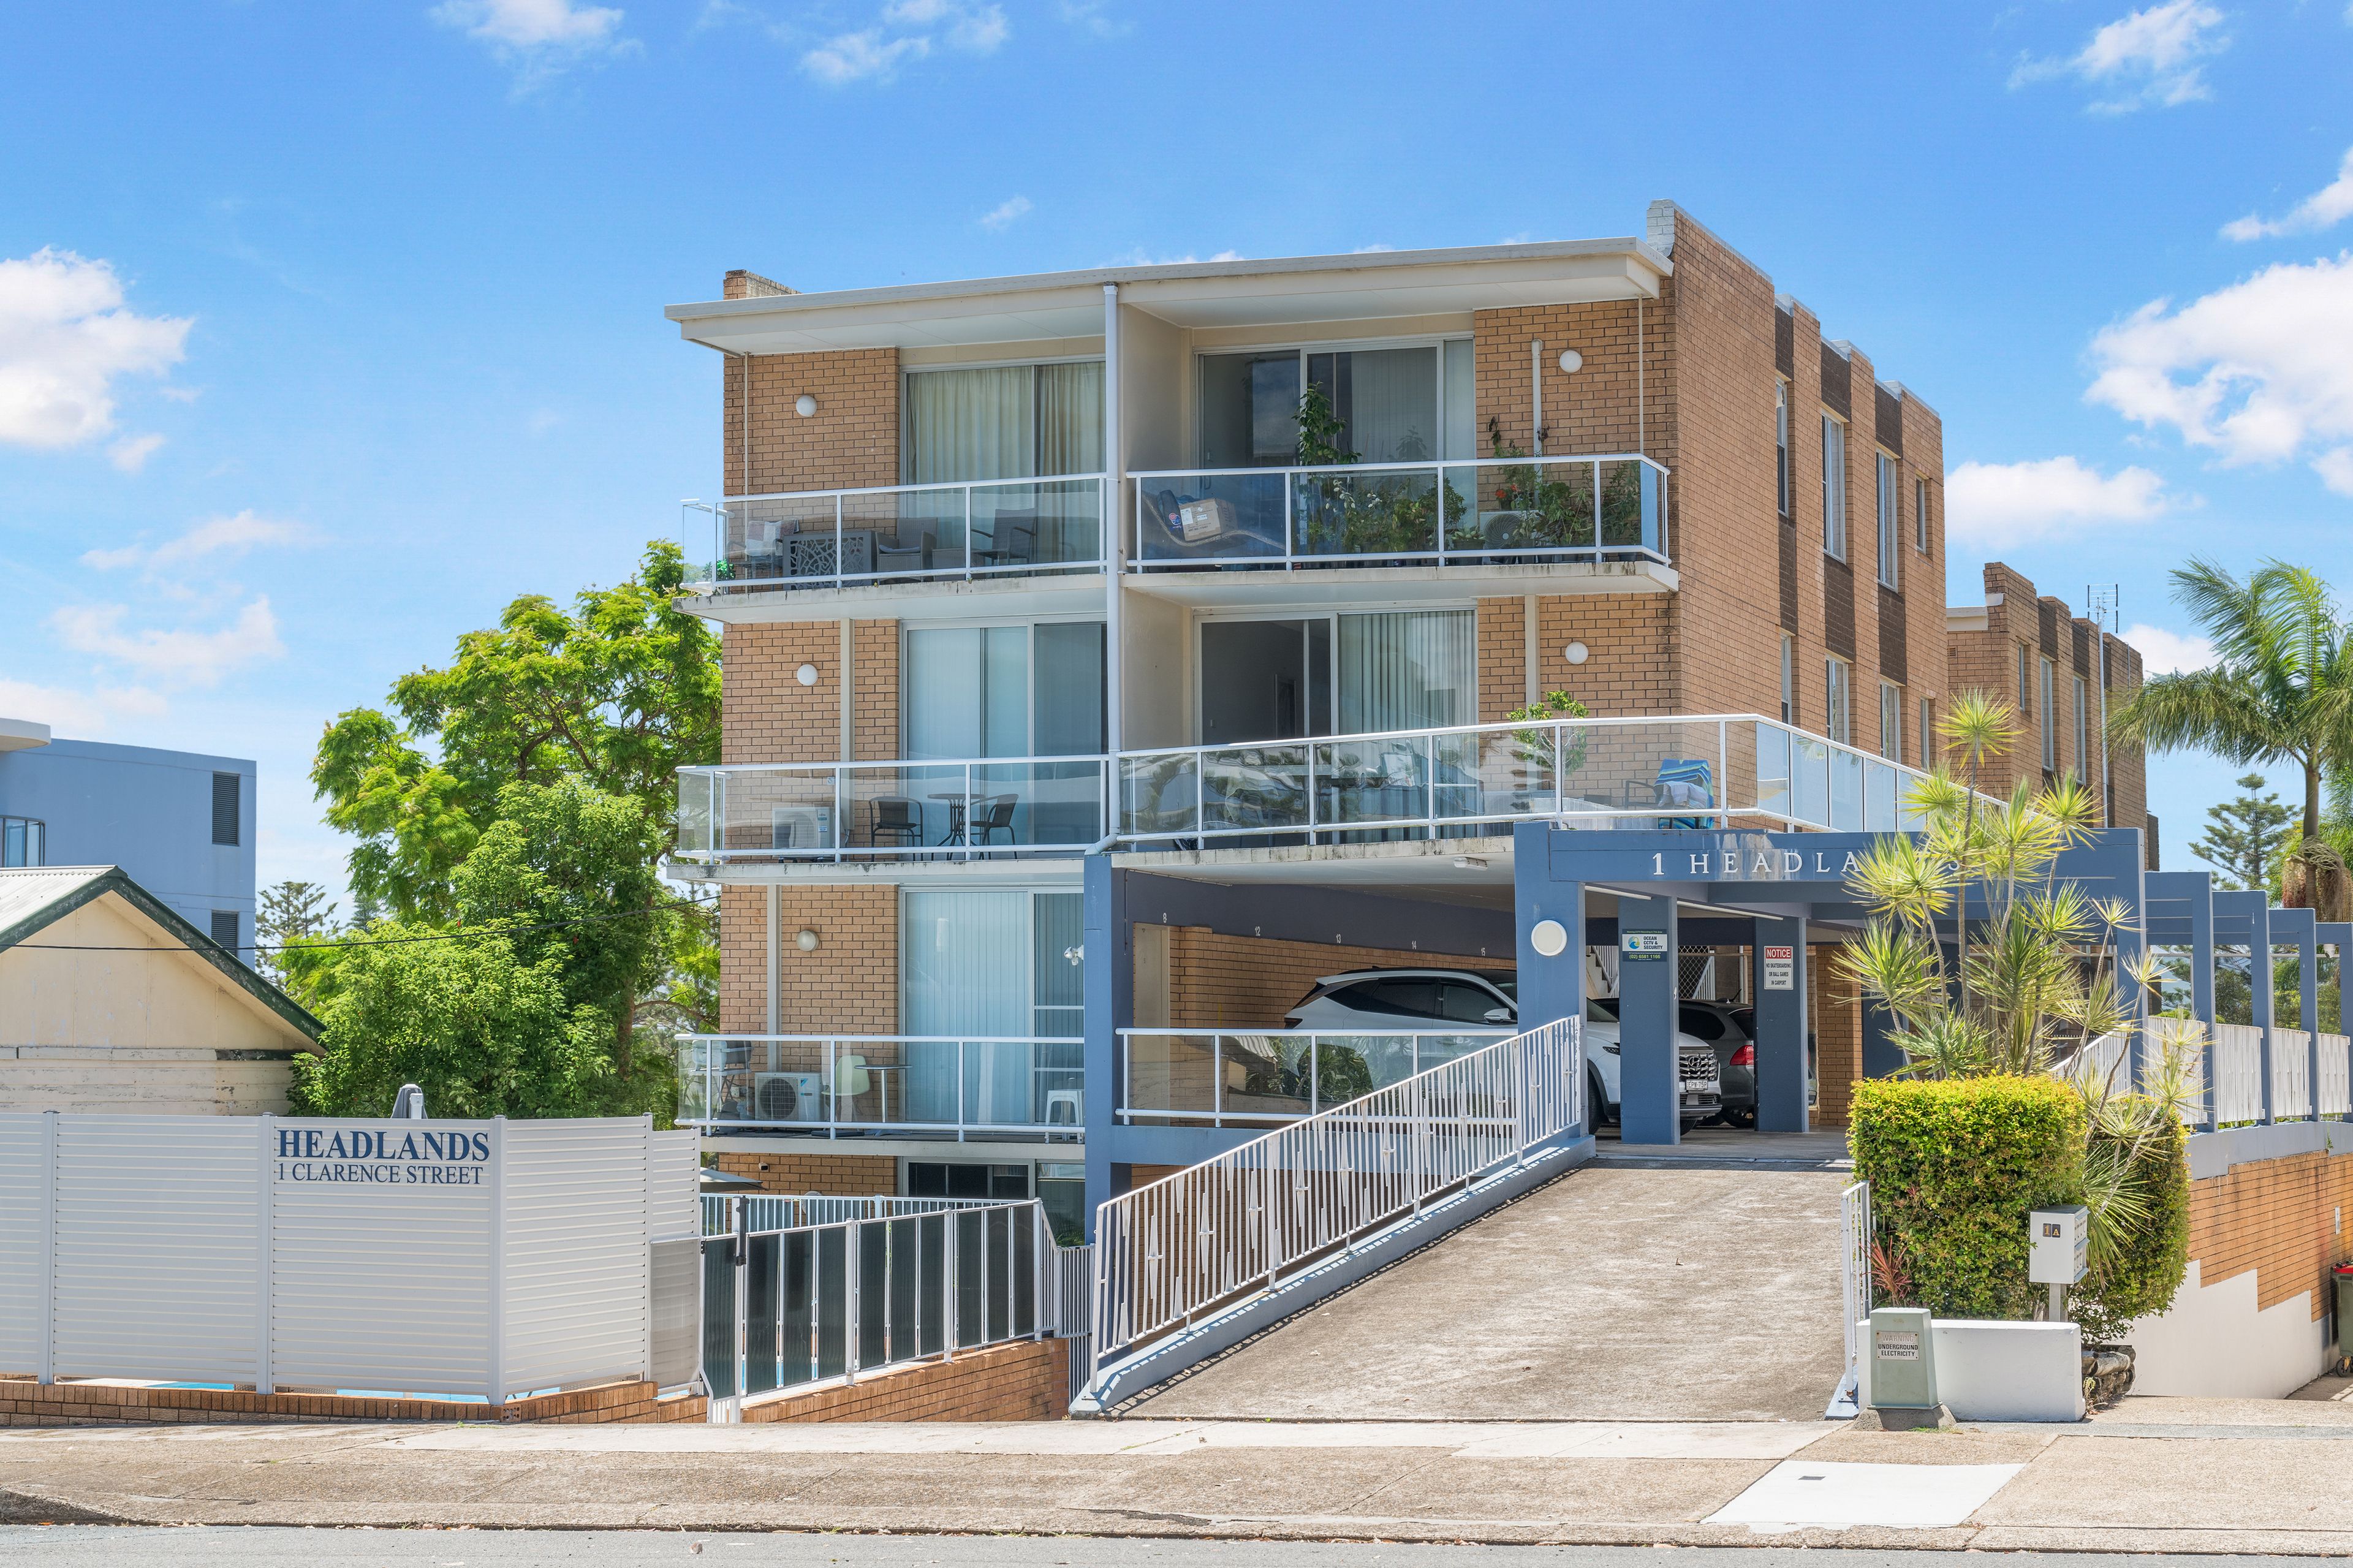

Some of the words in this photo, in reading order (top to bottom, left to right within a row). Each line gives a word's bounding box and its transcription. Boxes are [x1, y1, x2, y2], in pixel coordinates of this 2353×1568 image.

[1652, 852, 1665, 876] 1
[1162, 912, 1167, 923] 8
[1254, 926, 1261, 937] 12
[1336, 933, 1342, 944] 13
[1411, 940, 1417, 950] 14
[1767, 949, 1790, 958] NOTICE
[277, 1130, 490, 1161] HEADLANDS
[279, 1163, 285, 1180] 1
[292, 1163, 401, 1183] CLARENCE
[407, 1165, 483, 1184] STREET
